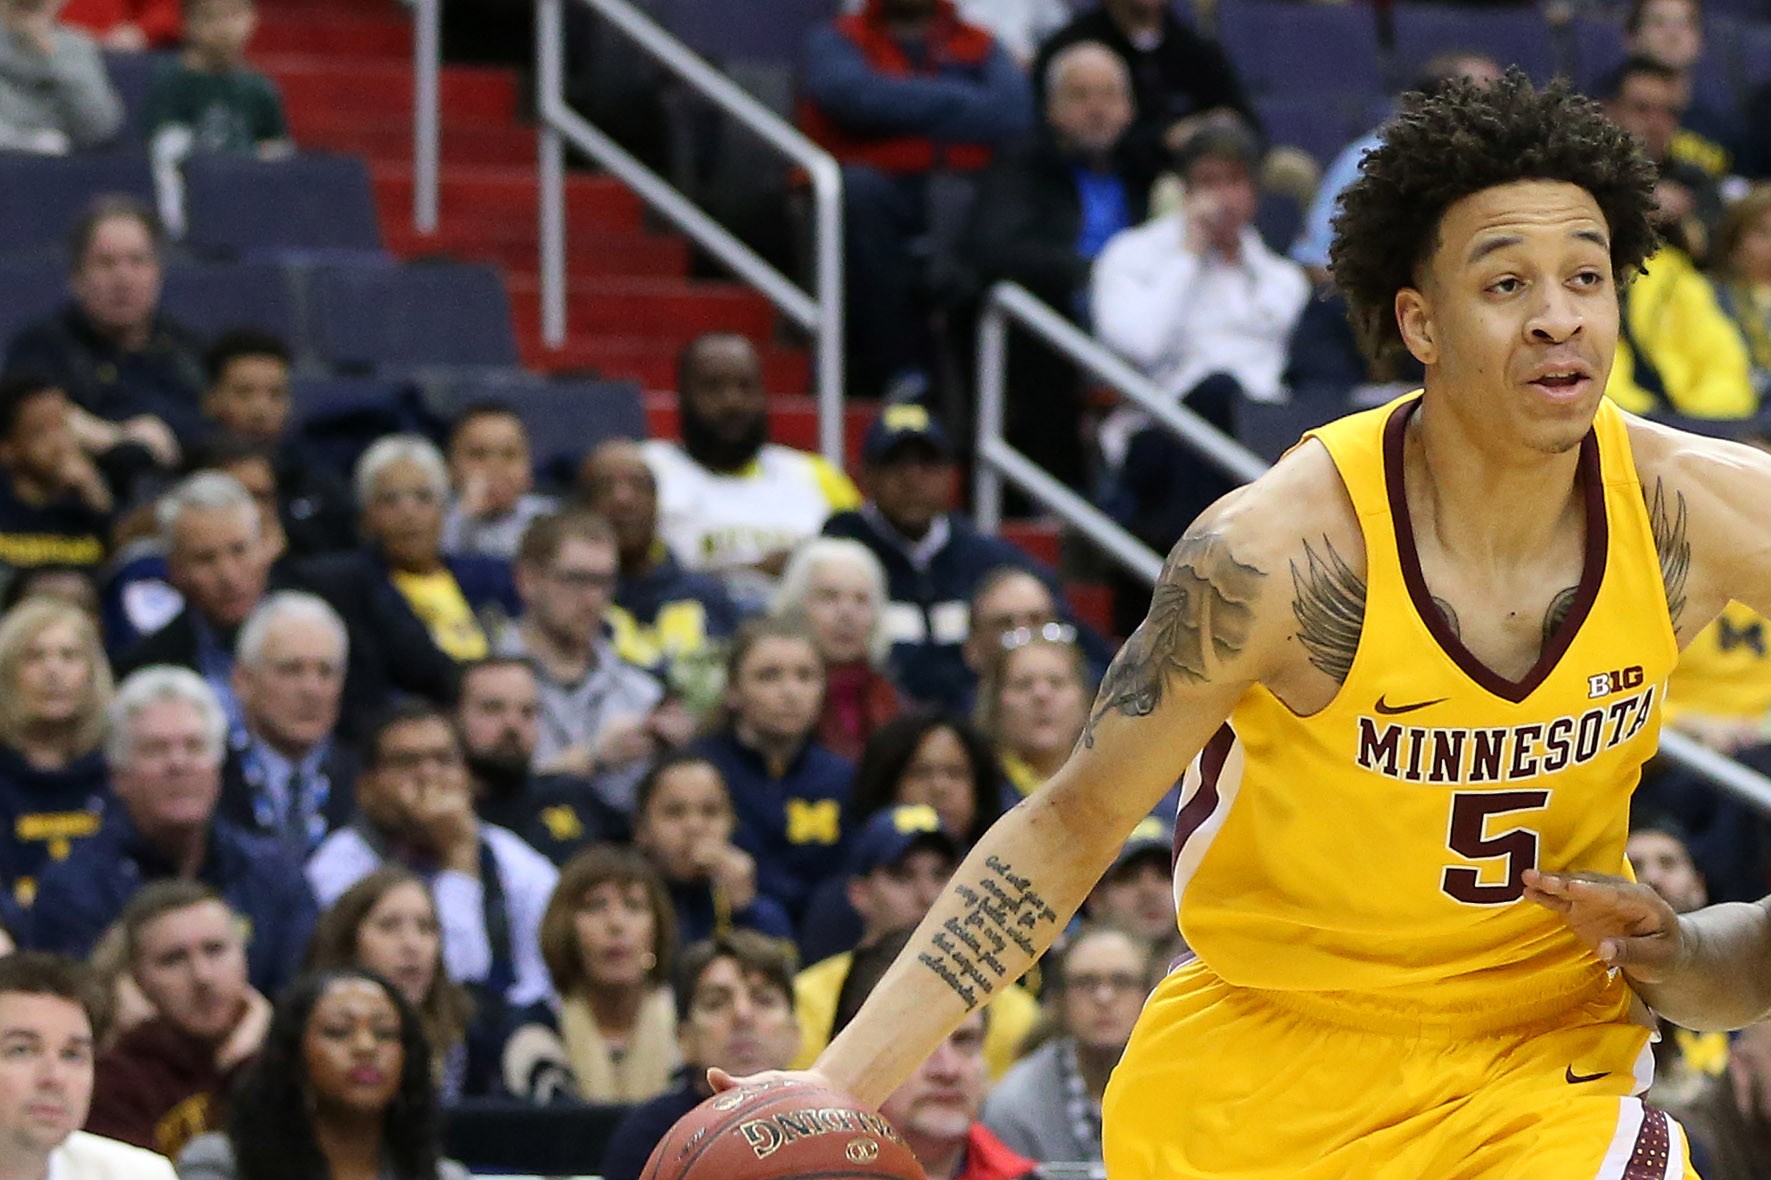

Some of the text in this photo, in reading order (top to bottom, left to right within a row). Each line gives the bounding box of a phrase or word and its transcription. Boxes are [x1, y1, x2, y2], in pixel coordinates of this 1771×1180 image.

[1356, 684, 1658, 785] MINNESOTA
[1440, 789, 1553, 909] 5
[740, 1107, 908, 1160] ALDING
